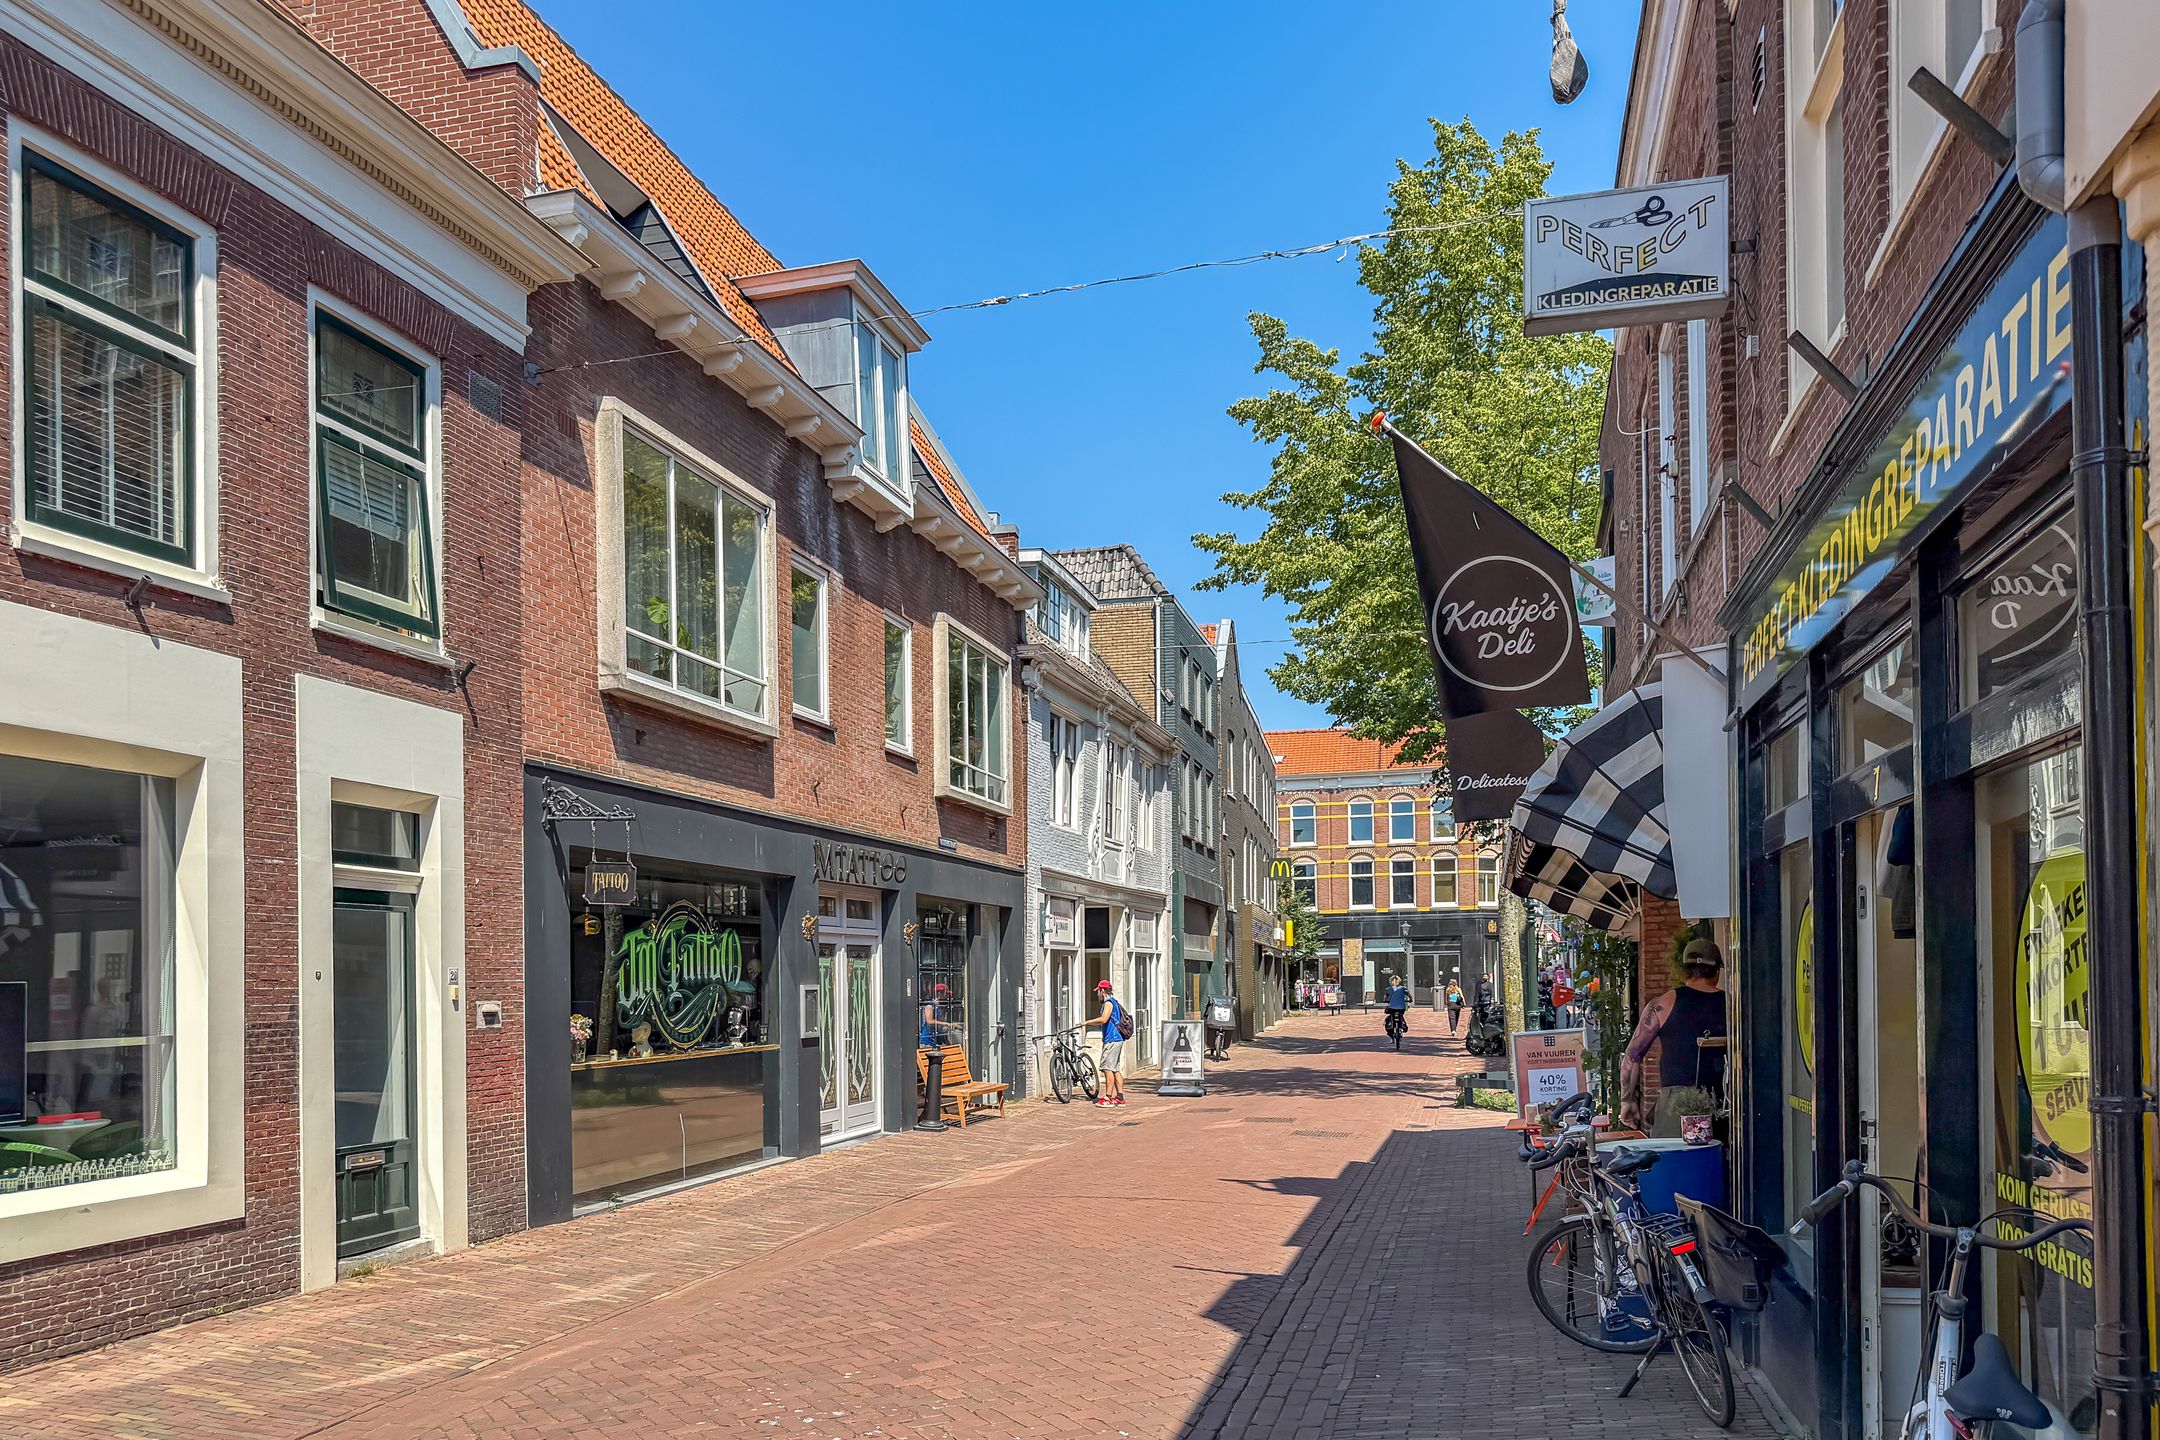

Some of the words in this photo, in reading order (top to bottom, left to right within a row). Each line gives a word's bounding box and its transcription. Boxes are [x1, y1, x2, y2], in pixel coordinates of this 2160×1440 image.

[1537, 195, 1715, 274] PERFECT
[1537, 276, 1718, 310] KLEDINGREPARATIE
[1742, 579, 1796, 691] PERFECT
[1797, 244, 2072, 629] KLEDINGREPARATIE
[1442, 592, 1559, 636] Kaatje's
[1477, 628, 1536, 659] Deli
[1456, 773, 1528, 791] Delicatess
[592, 872, 629, 894] TATTOO
[1544, 1050, 1576, 1058] VUUREN
[1539, 1074, 1567, 1085] 40%
[1540, 1085, 1567, 1093] KORTING
[1996, 1172, 2026, 1207] KOM
[2029, 1184, 2091, 1220] GERUST
[1996, 1219, 2034, 1261] VOOR
[2036, 1240, 2093, 1289] GRATIS
